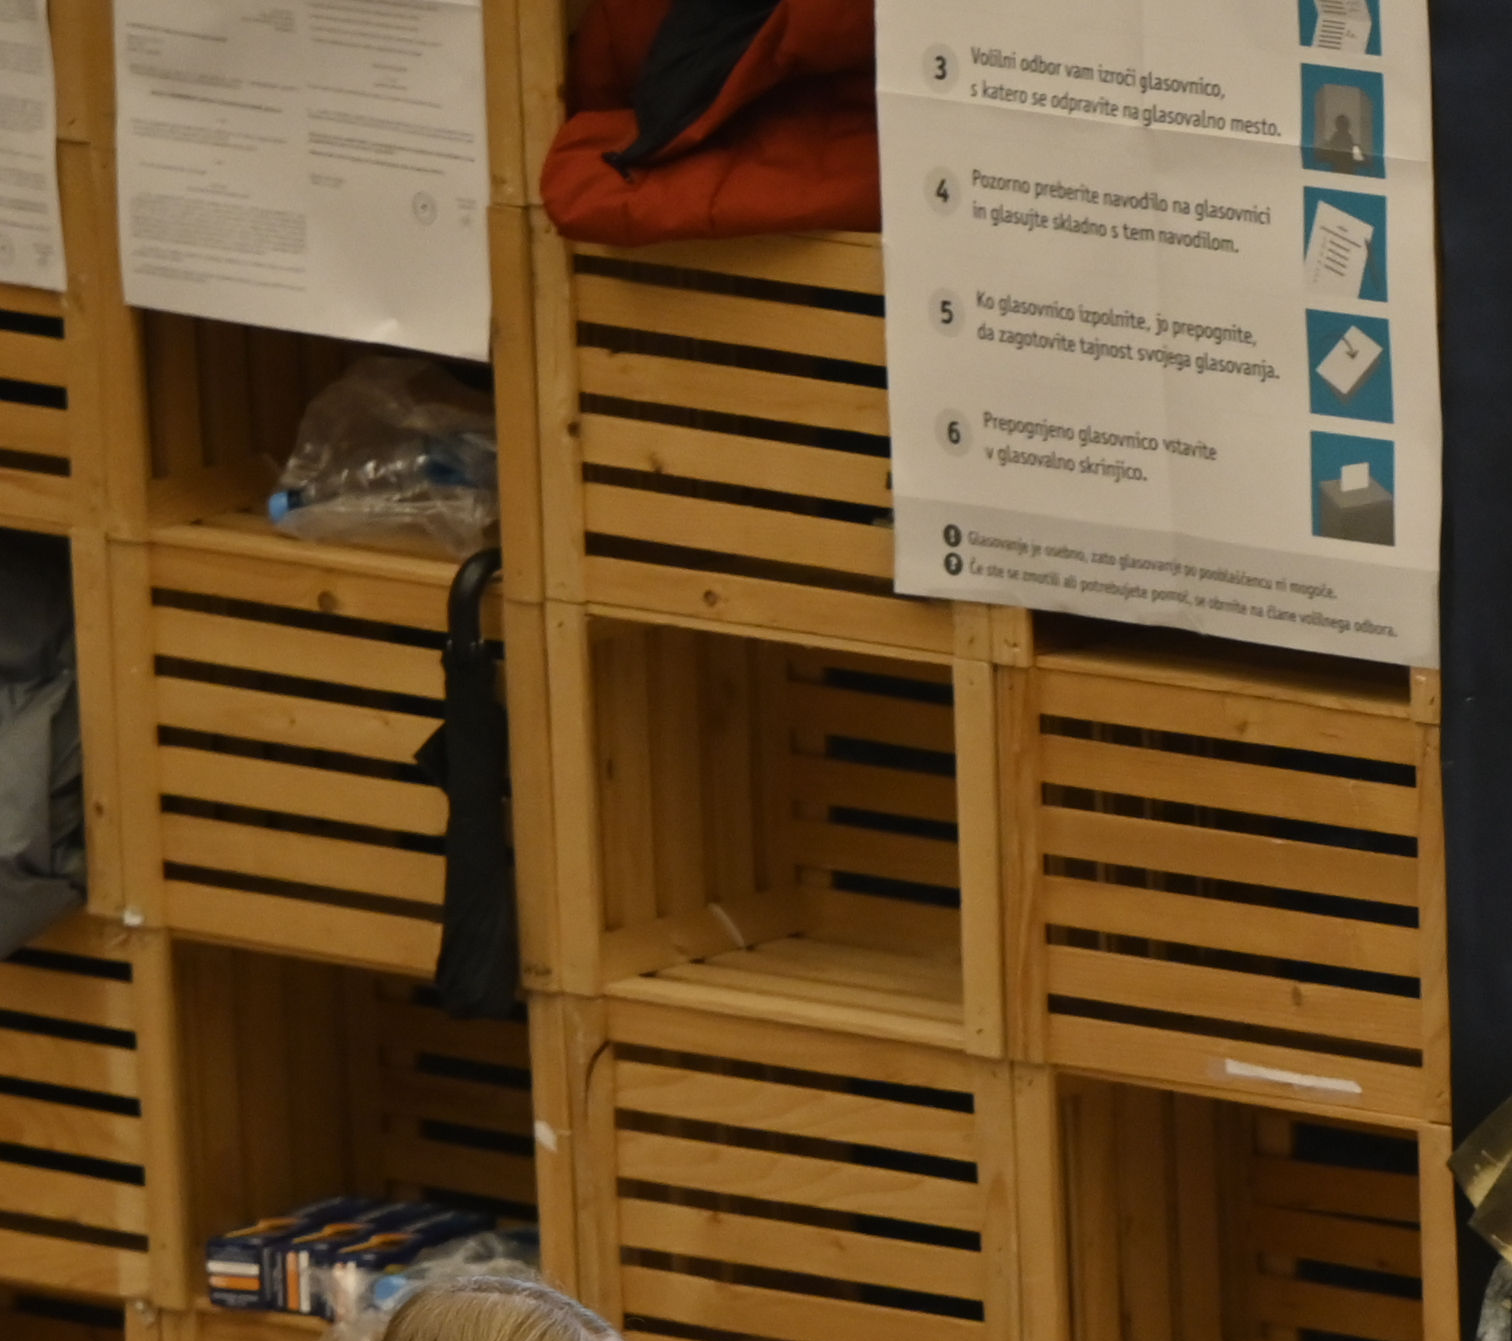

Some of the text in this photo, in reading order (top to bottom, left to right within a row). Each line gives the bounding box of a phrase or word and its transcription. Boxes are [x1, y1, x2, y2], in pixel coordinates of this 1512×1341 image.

[933, 55, 947, 80] 3
[1020, 54, 1061, 76] odbor
[1064, 64, 1094, 80] vam
[1097, 63, 1136, 87] izroči
[1139, 71, 1226, 99] glasovnico,
[970, 80, 1282, 137] s katero se odpravite na glasovalno mesto.
[935, 178, 949, 203] 4
[972, 168, 1271, 225] Pozorno preberite navodilo na glasovnici
[972, 200, 1239, 253] in glasujte skladno s tem navodilom.
[940, 300, 954, 325] 5
[976, 290, 995, 310] Ko
[998, 294, 1075, 321] glasovnico
[1078, 303, 1151, 332] izpolnite,
[1172, 320, 1257, 347] prepognite,
[977, 322, 1280, 383] da zagotovite tajnost svojega glasovanja.
[947, 420, 961, 445] 6
[983, 411, 1218, 461] Prepognjeno glasovnico vstavite
[985, 445, 1148, 483] v glasovalno skrinjico.
